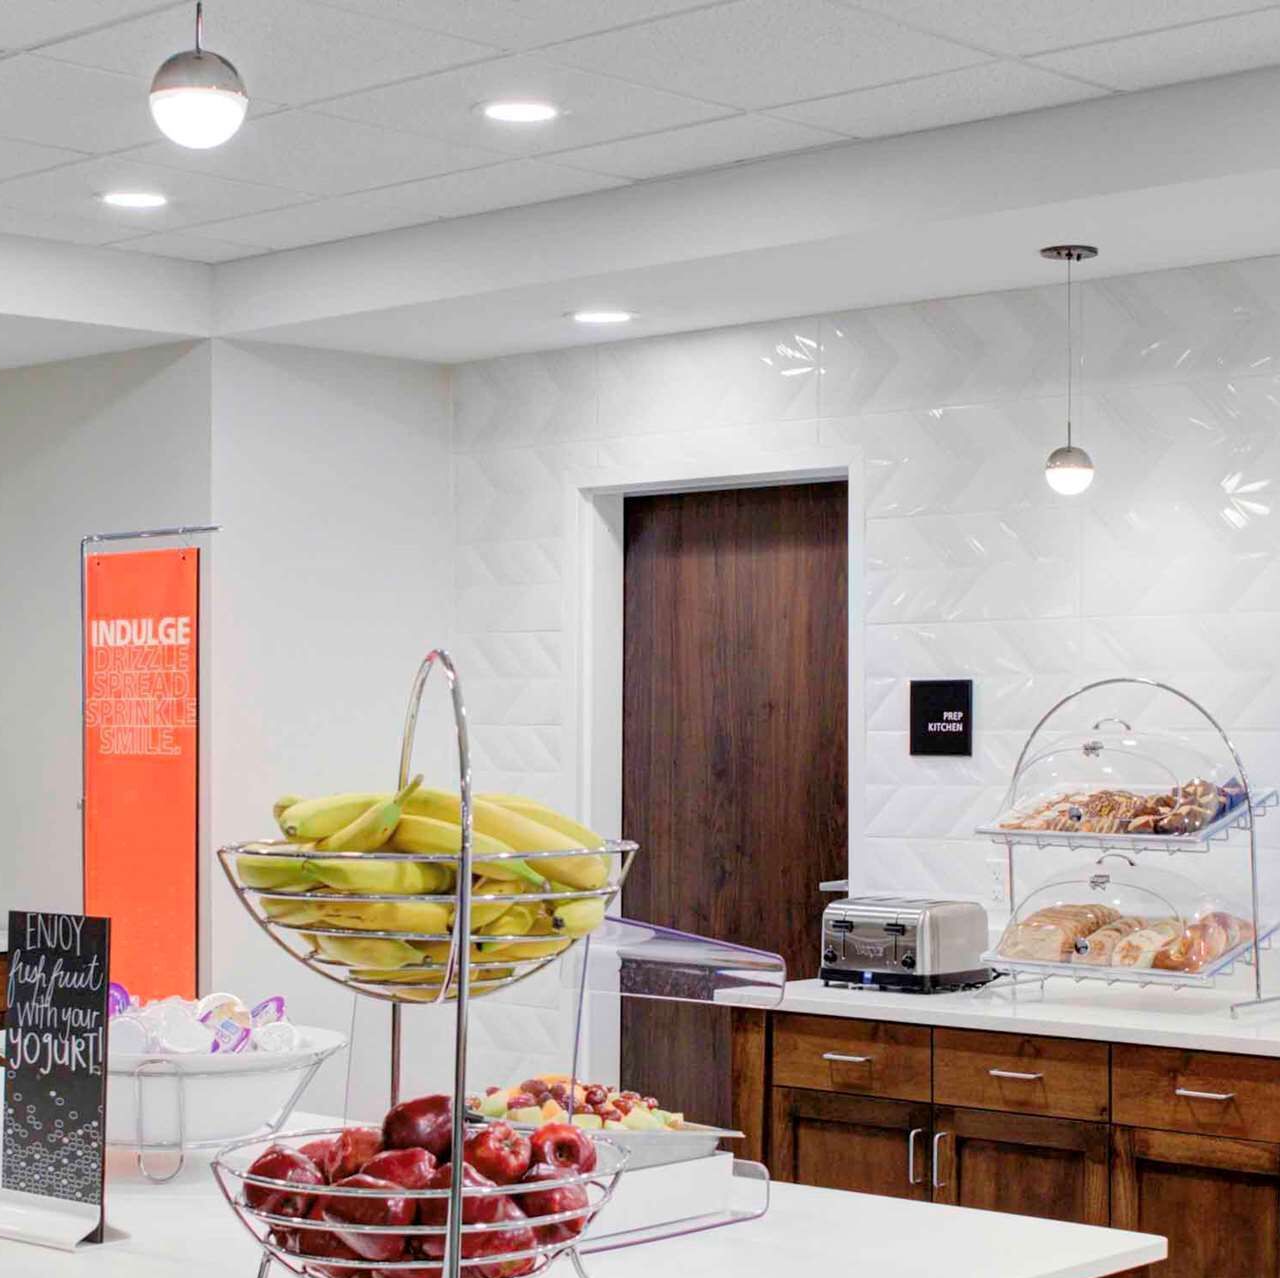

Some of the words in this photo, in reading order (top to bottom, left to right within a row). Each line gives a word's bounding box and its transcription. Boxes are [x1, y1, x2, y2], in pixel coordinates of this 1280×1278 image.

[91, 617, 191, 647] INDULGE
[93, 644, 190, 673] DRIZZLE
[92, 671, 191, 700] SPREAD
[86, 696, 198, 728] SPRINKLE
[927, 722, 963, 732] KITCHEN
[943, 711, 963, 721] PREP
[99, 725, 182, 756] SMILE.
[26, 912, 86, 957] ENJOY
[39, 957, 105, 1006] fruit
[16, 994, 58, 1029] with
[61, 997, 101, 1047] your
